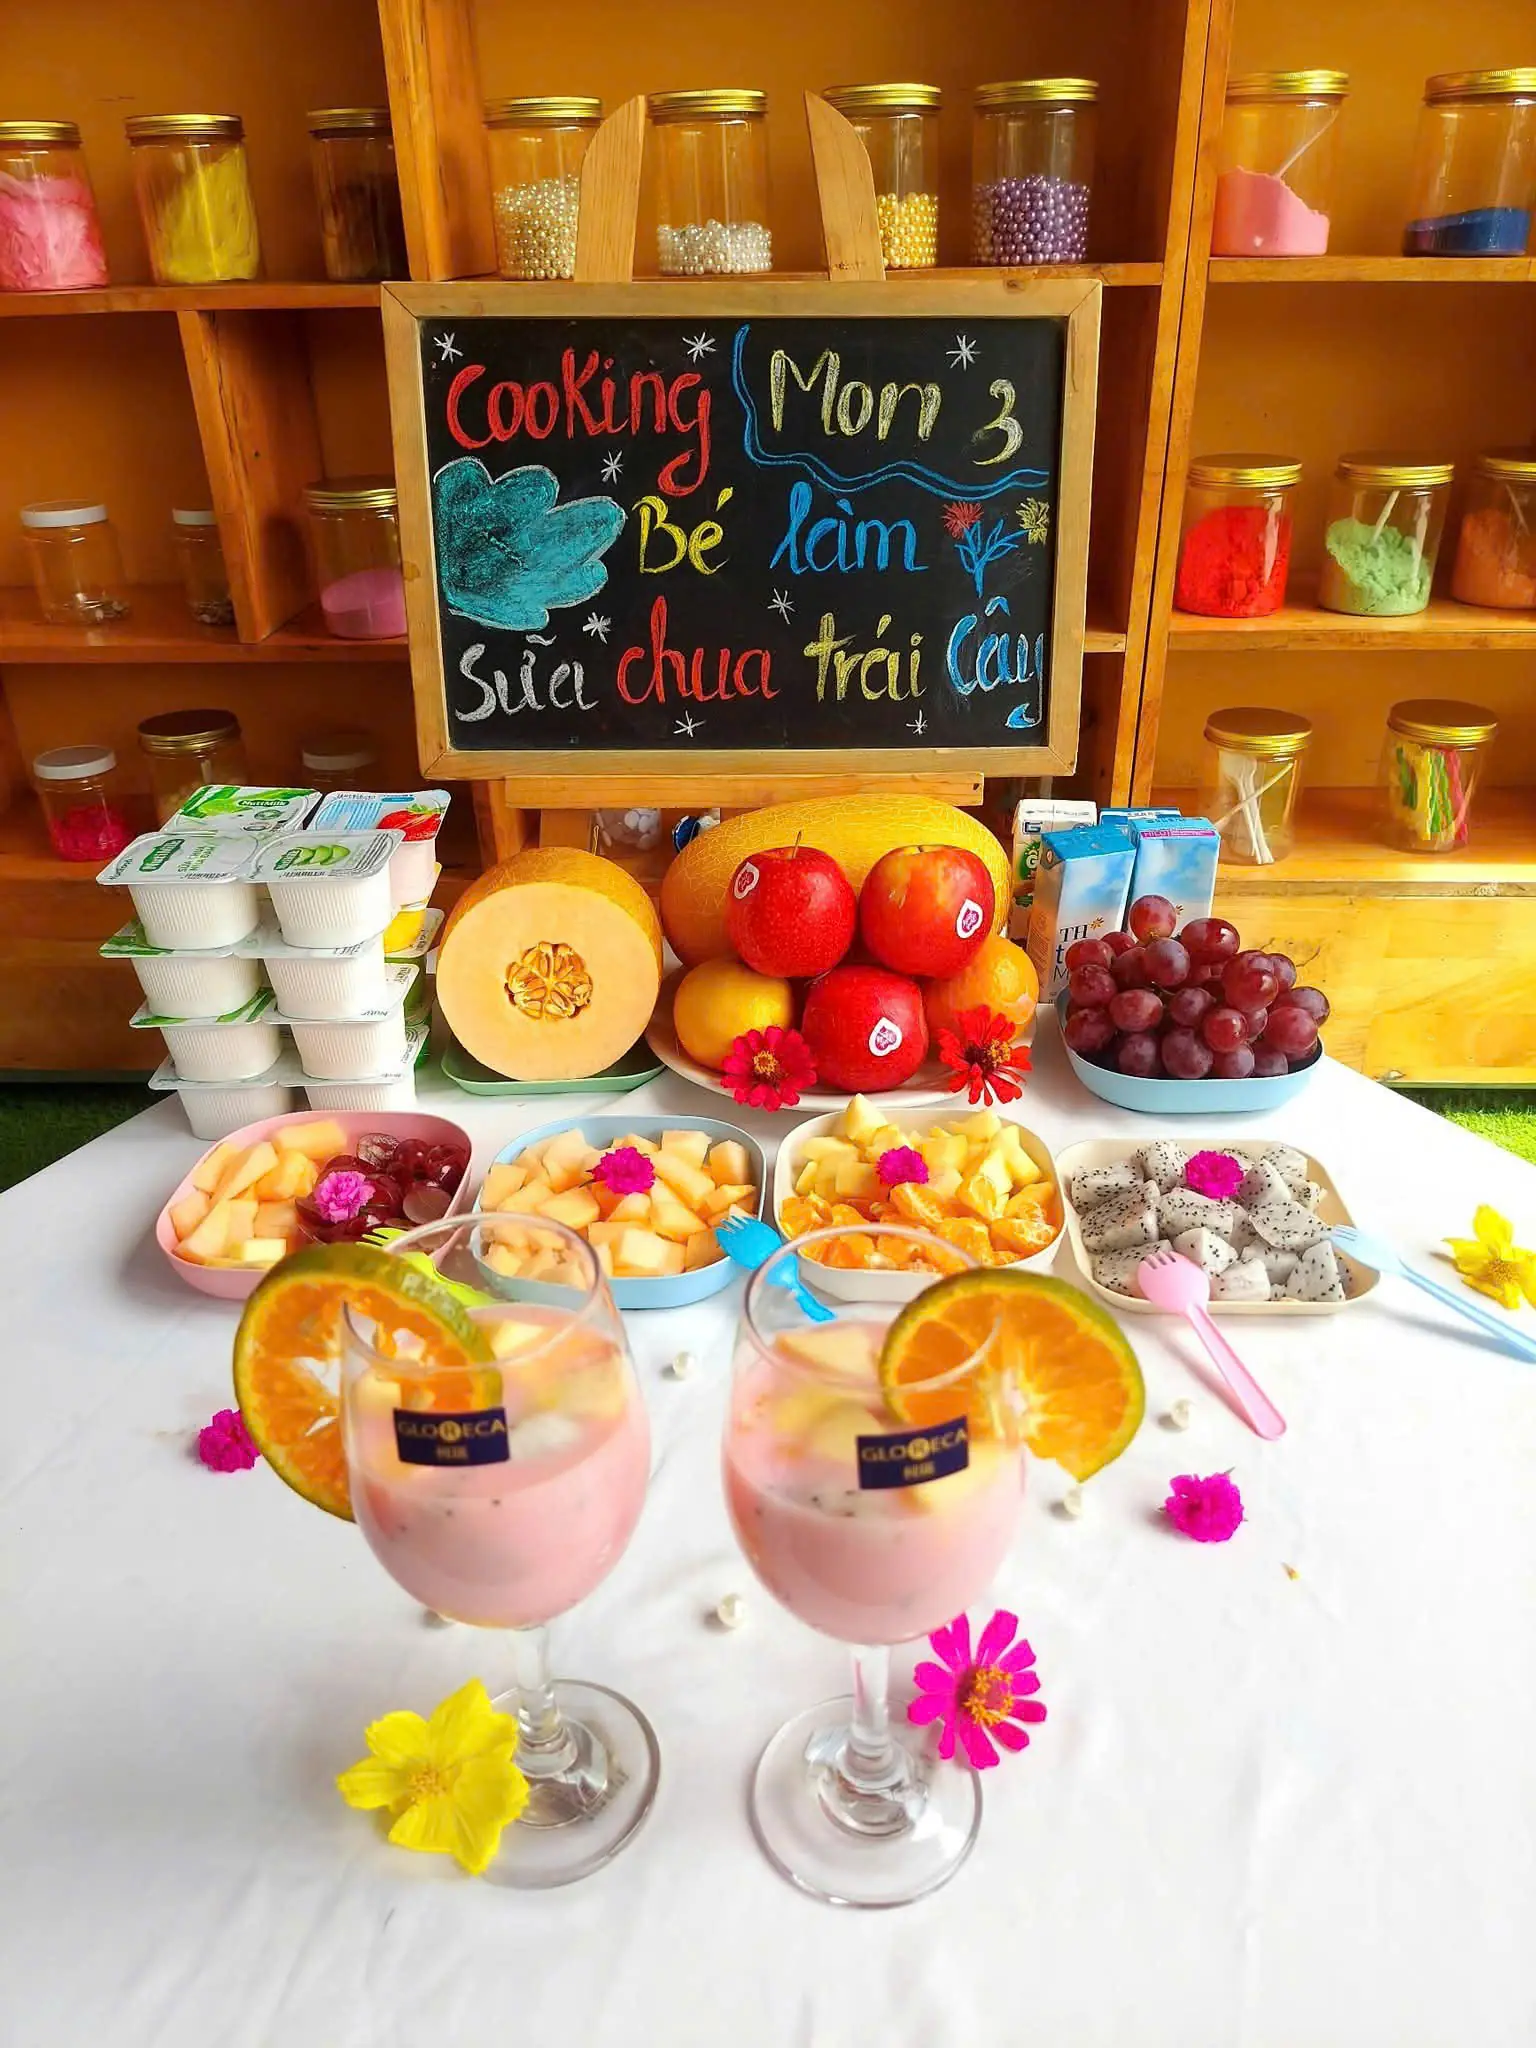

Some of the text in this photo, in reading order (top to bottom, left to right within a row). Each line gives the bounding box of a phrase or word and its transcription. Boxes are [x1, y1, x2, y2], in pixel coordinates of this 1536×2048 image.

[770, 348, 1024, 466] Mon 3
[636, 481, 929, 577] Bé làm
[455, 634, 600, 722] Sữa
[617, 596, 781, 704] chua
[803, 612, 928, 702] trái
[1059, 924, 1088, 942] TH
